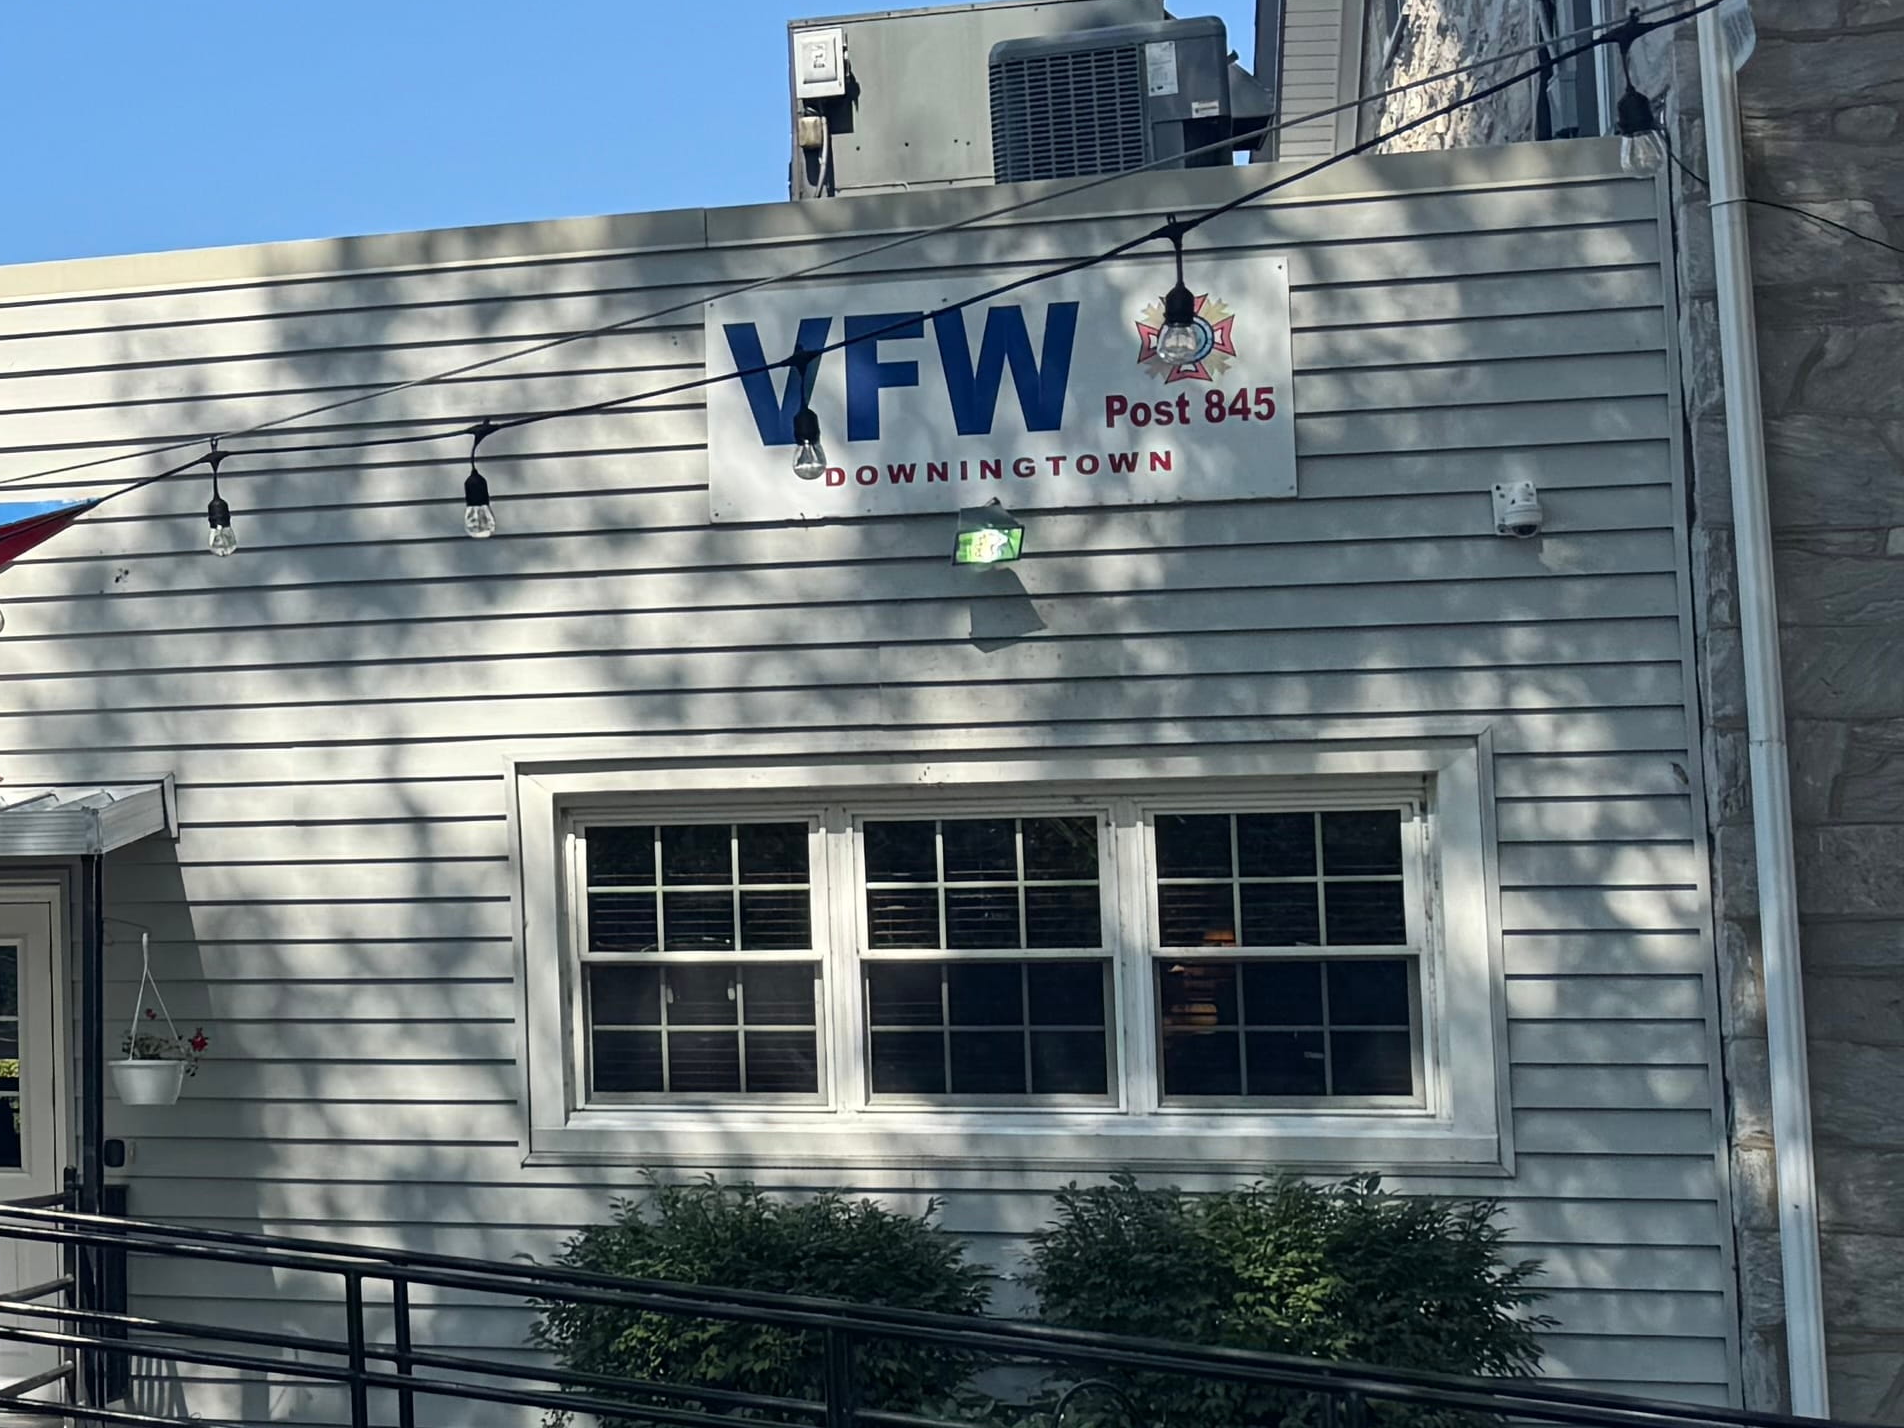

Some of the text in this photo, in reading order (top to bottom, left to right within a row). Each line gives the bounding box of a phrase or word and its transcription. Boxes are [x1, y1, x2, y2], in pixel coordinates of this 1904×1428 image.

[722, 301, 1080, 447] VFW
[1105, 386, 1276, 429] Post 845
[825, 450, 1173, 487] DOWNINGTOWN
